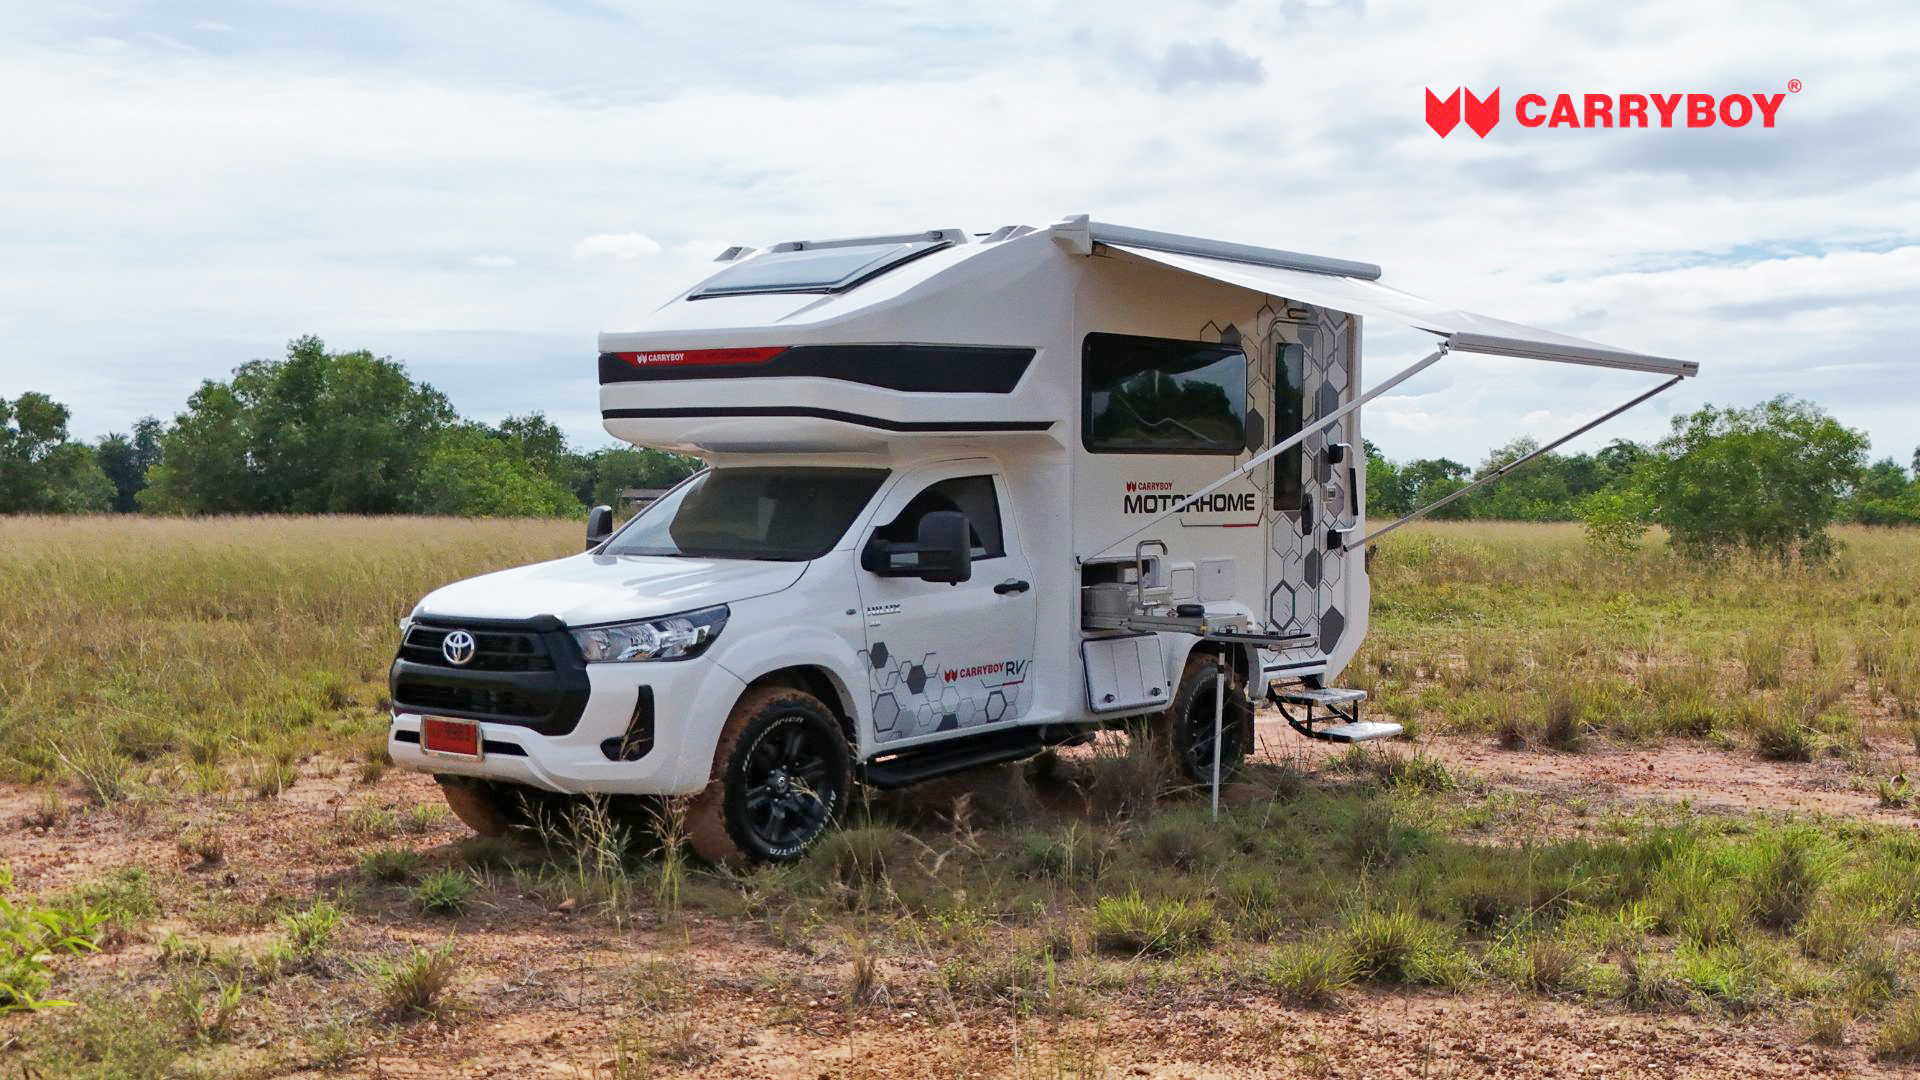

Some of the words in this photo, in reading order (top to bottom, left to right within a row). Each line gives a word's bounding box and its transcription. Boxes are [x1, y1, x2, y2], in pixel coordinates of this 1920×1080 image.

[648, 353, 685, 362] CARRYBOY
[1138, 482, 1173, 490] CARRYBOY
[960, 662, 1004, 678] CARRYBOY
[1005, 660, 1026, 676] RV
